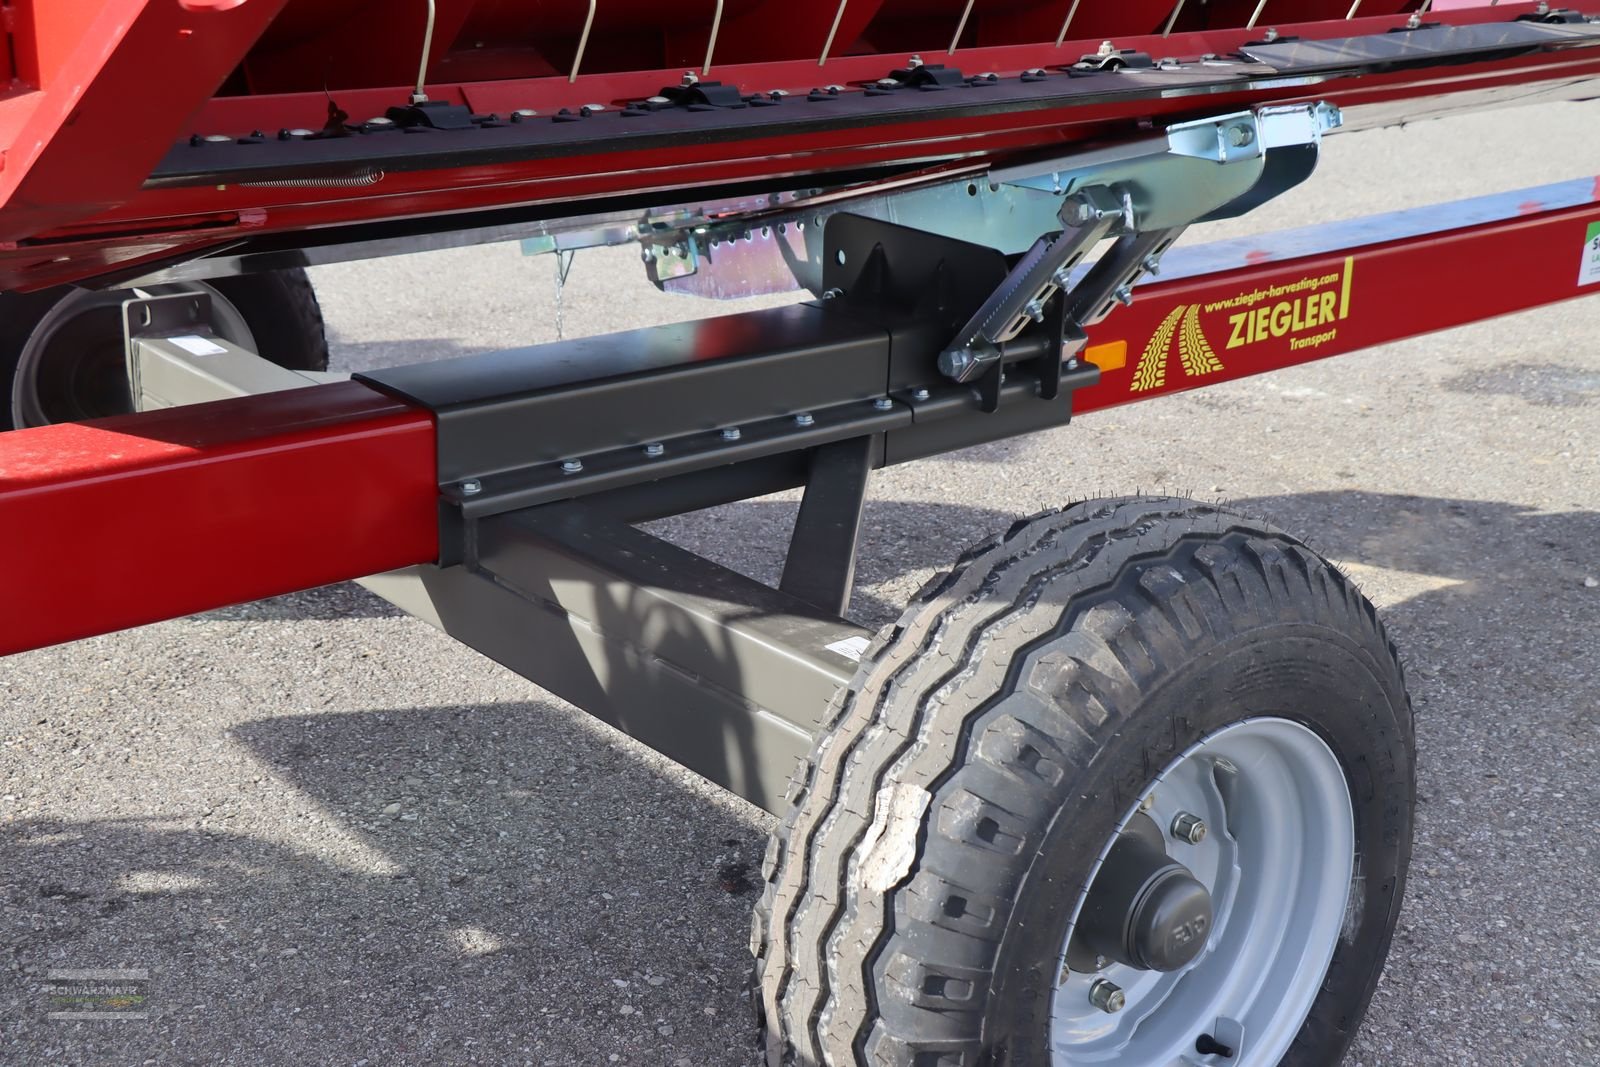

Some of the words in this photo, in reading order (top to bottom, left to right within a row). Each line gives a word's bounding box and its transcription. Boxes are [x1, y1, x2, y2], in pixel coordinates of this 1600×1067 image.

[1205, 273, 1338, 313] www.ziegler-harvesting.com
[1226, 291, 1336, 349] ZIEGLER
[1290, 328, 1336, 350] Transport
